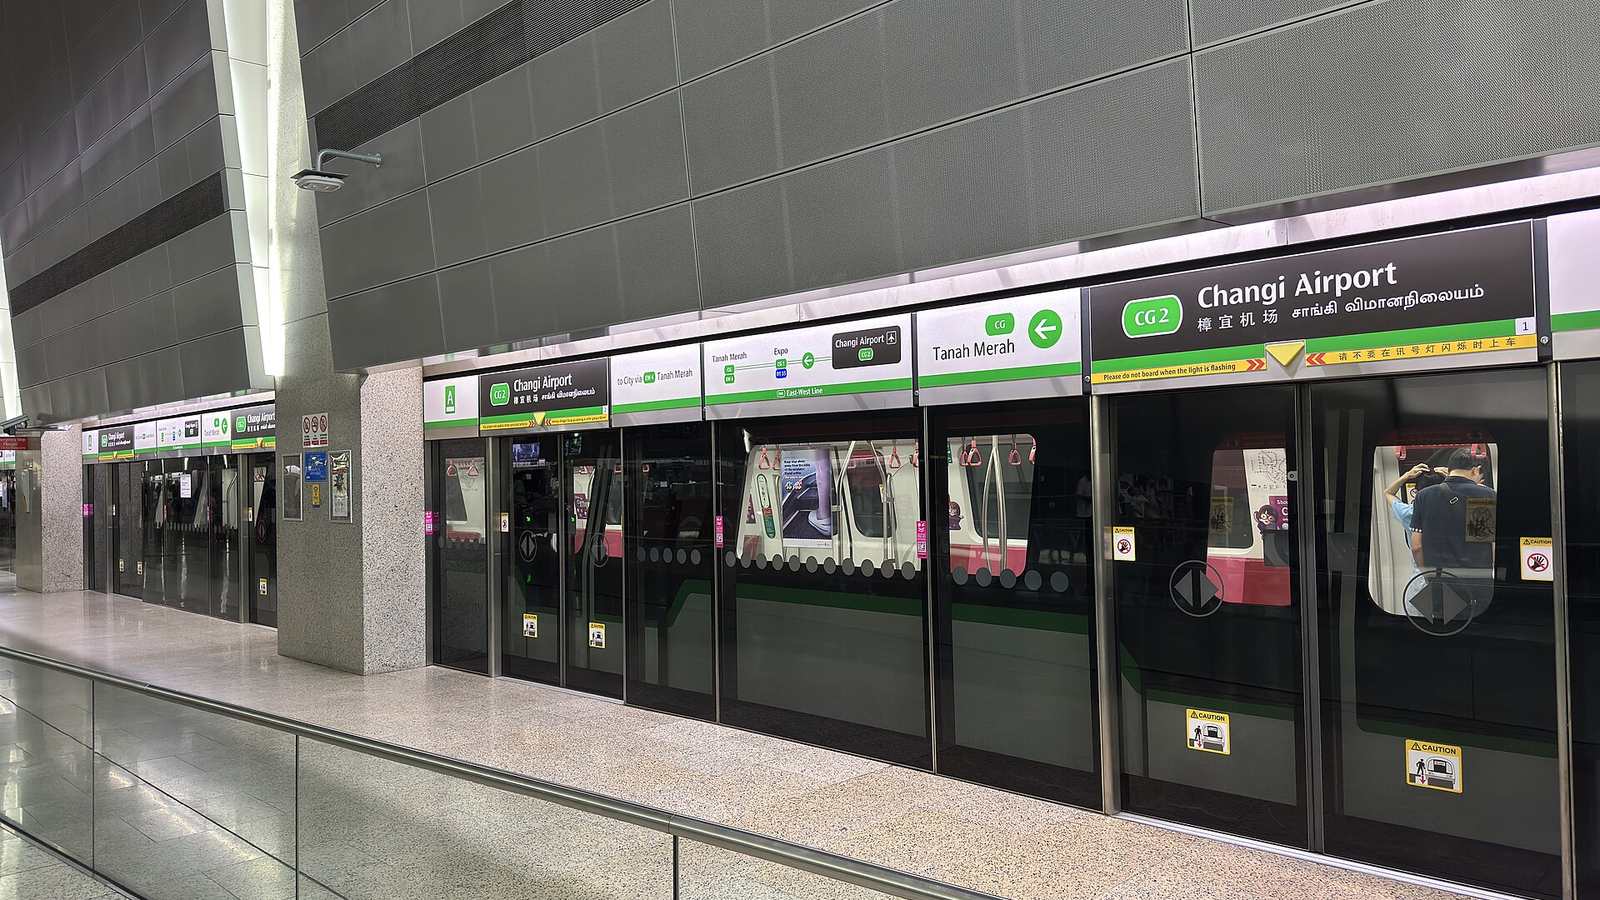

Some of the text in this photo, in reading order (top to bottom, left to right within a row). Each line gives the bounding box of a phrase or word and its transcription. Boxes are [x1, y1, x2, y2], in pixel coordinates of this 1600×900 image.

[1197, 262, 1397, 309] Changi Airport
[1291, 283, 1485, 319] சாங்கி விமானநிலையம்
[994, 320, 1006, 329] CG
[1197, 308, 1278, 333] 樟宜机场
[1522, 321, 1529, 331] 1
[835, 334, 885, 349] Changi Airport
[712, 351, 748, 362] Tanah Merah
[773, 347, 788, 356] Expo
[933, 339, 1015, 361] Tanah Merah
[624, 376, 634, 386] City
[657, 371, 674, 380] Tanah
[674, 368, 692, 378] Merah
[1142, 369, 1159, 377] board
[1188, 366, 1203, 374] light
[1210, 363, 1236, 371] flashing
[513, 373, 572, 392] Changi Airport
[447, 390, 454, 404] A
[786, 389, 810, 397] East-West
[1198, 713, 1225, 721] CAUTION
[1422, 744, 1456, 754] CAUTION
